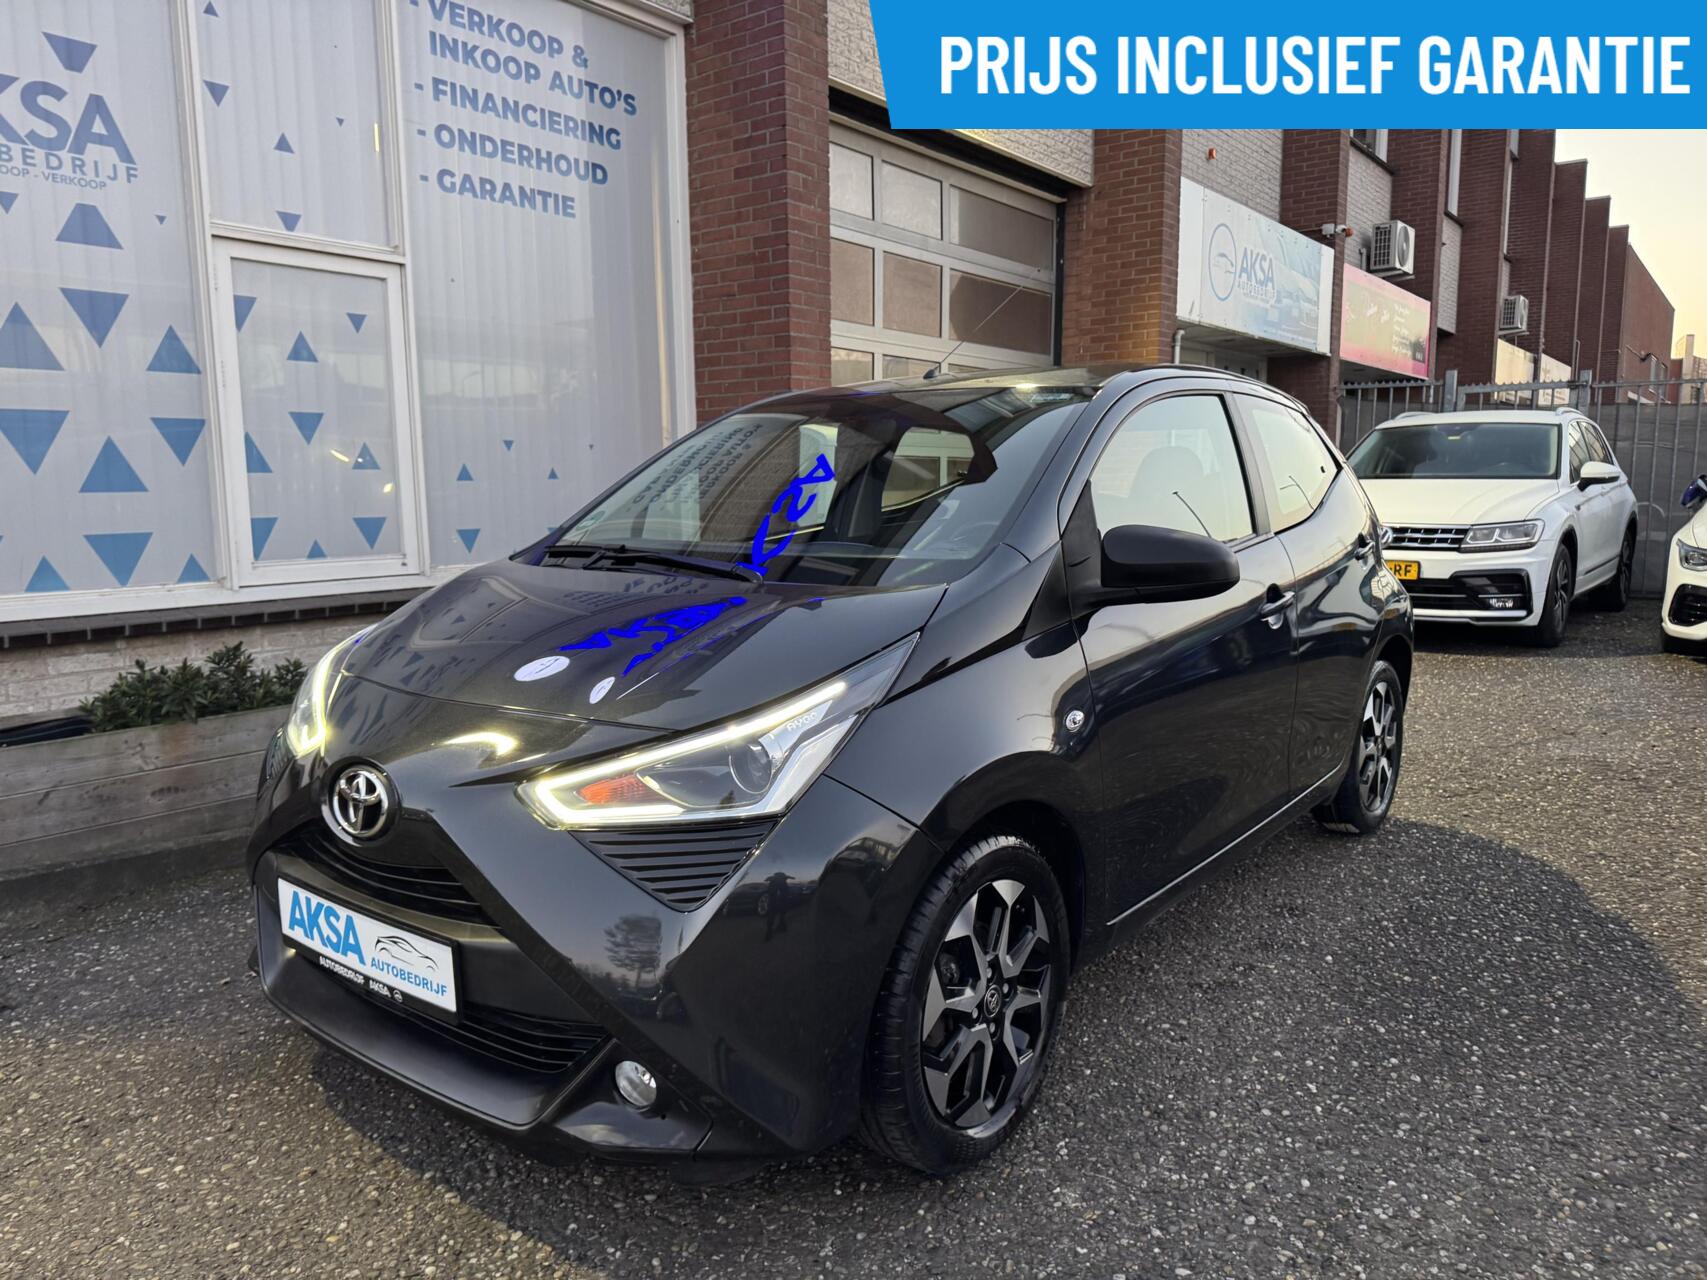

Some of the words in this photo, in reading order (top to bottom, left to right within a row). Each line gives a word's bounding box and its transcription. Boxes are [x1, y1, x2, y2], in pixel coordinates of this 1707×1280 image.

[428, 0, 563, 58] VERKOOP
[572, 45, 588, 68] &
[429, 31, 541, 84] INKOOP
[549, 71, 637, 115] AUTO'S
[432, 77, 621, 150] FINANCIERING
[0, 143, 138, 183] BEDRIJF
[434, 124, 608, 185] ONDERHOUD
[41, 171, 107, 190] VERKOOP
[437, 168, 576, 218] GARANTIE
[1238, 247, 1275, 290] AKSA
[288, 890, 366, 966] AKSA
[369, 979, 391, 998] AKSA
[371, 957, 448, 997] AUTOBEDRIJF
